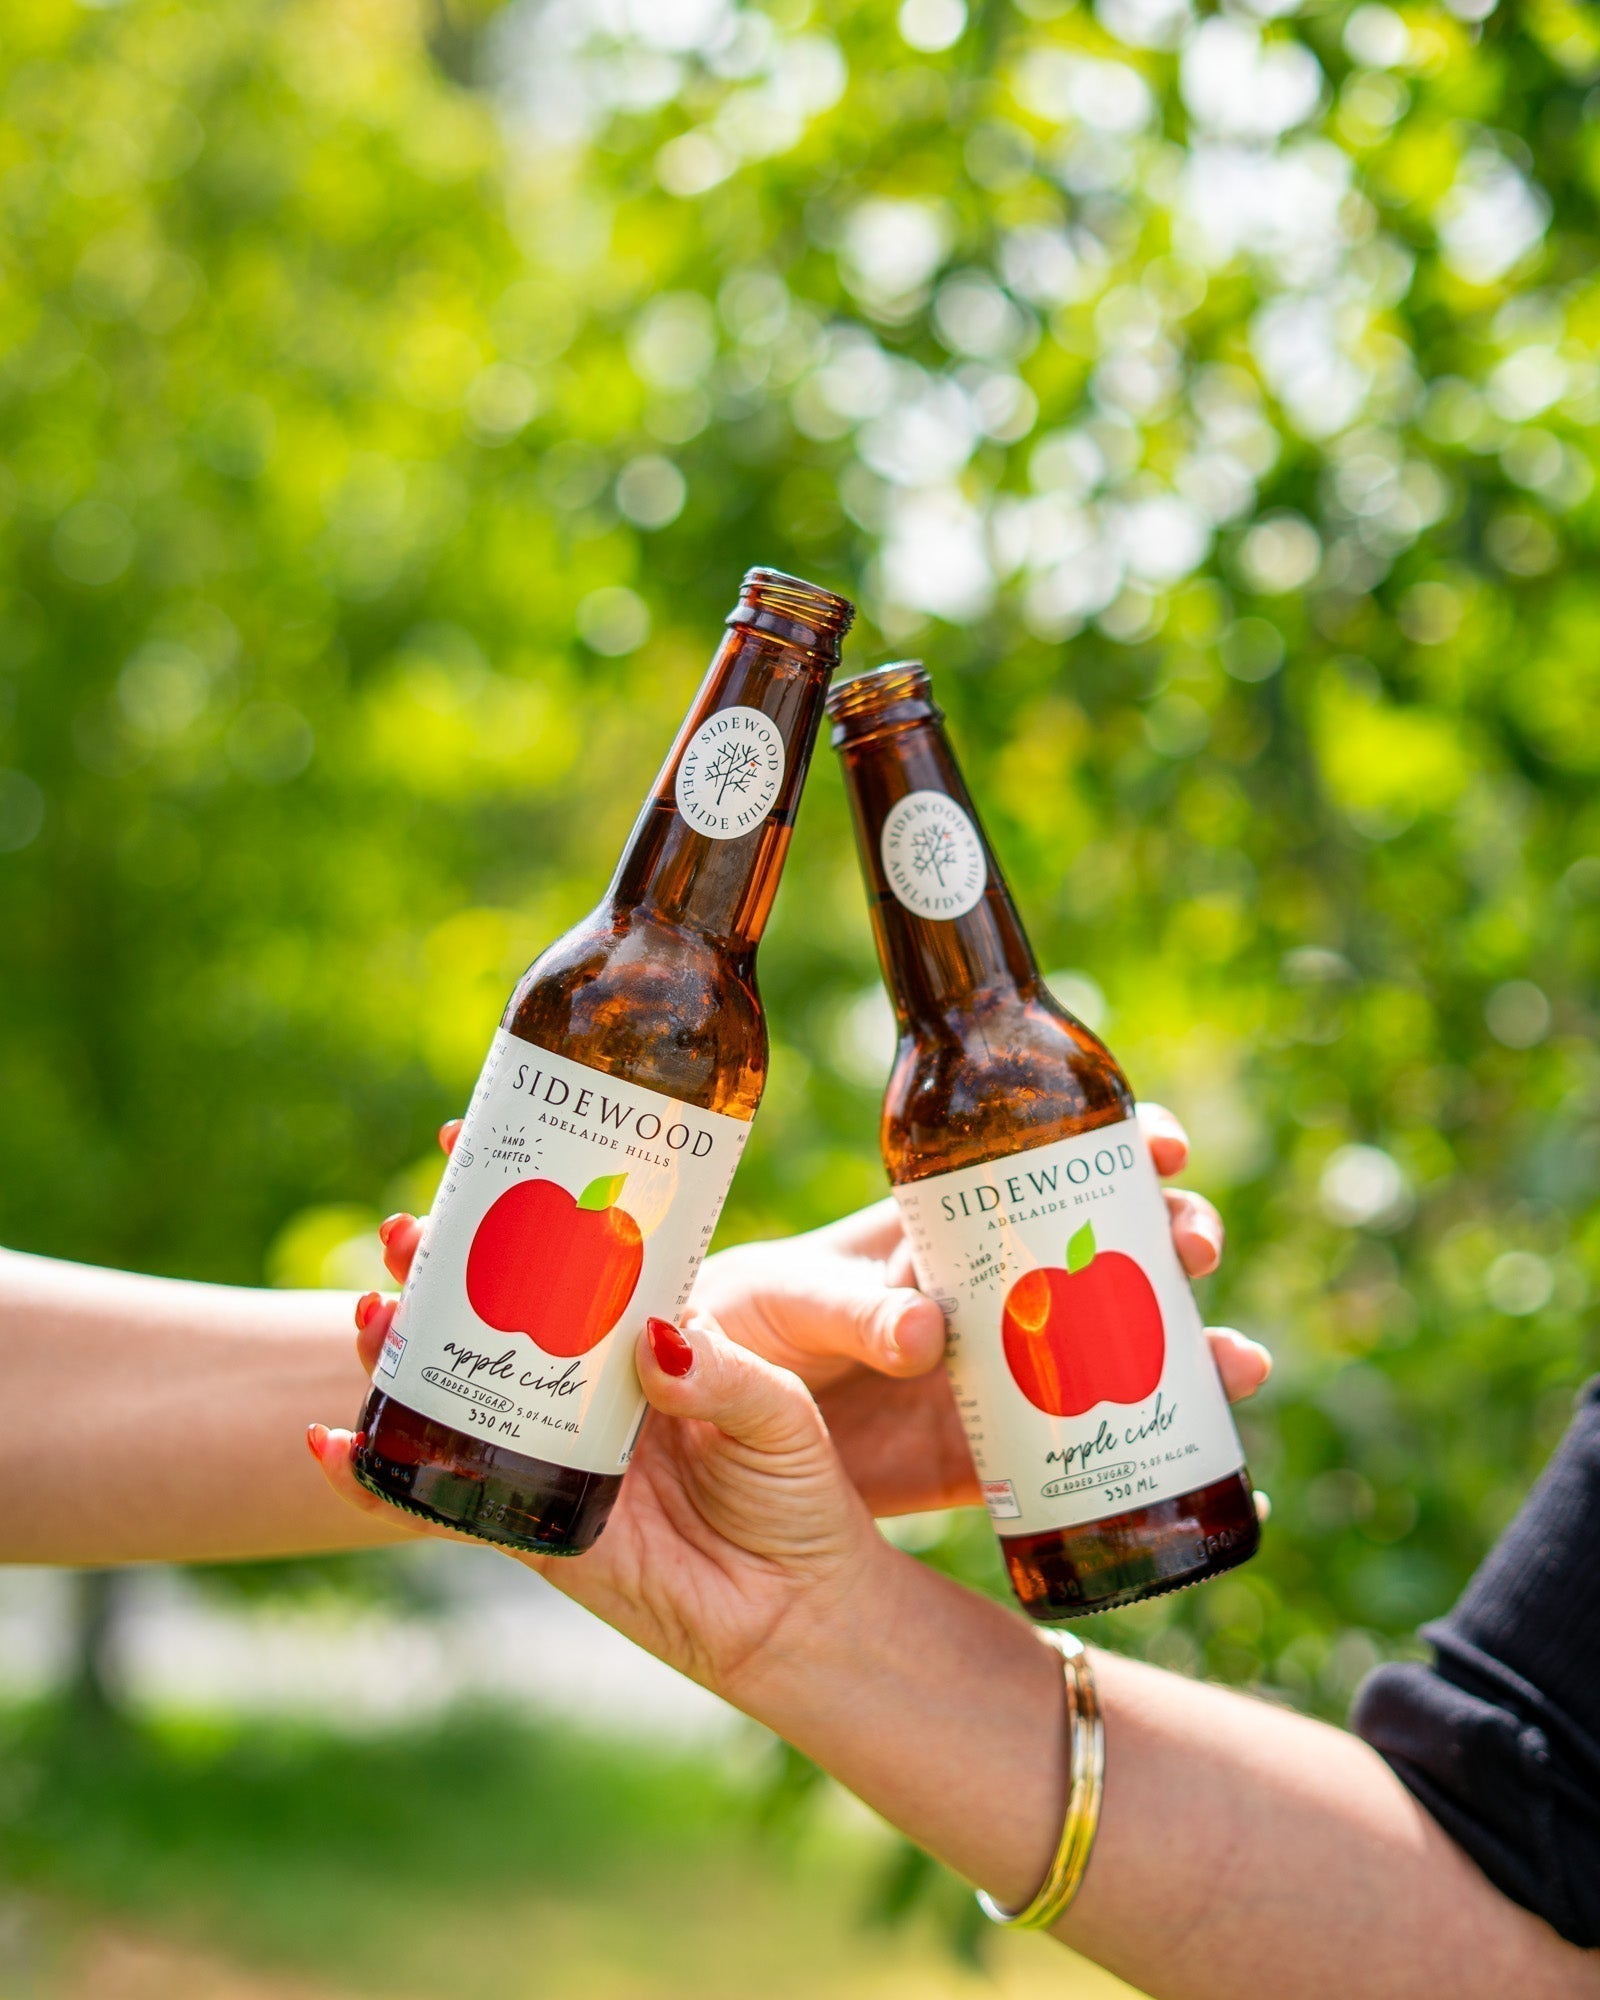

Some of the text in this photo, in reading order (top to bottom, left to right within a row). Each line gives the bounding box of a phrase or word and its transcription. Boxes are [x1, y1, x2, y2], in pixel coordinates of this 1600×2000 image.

[701, 717, 778, 771] SIDEWOOD
[682, 751, 776, 830] ADELAIDE HILLS
[889, 803, 966, 849] SIDEWOOD
[889, 840, 979, 910] ADELAIDE HILLS
[512, 1064, 714, 1157] SIDEWOOD
[492, 1149, 531, 1163] CRAFTED
[501, 1136, 526, 1147] HAND
[538, 1112, 671, 1168] ADELAIDE HILLS
[941, 1143, 1135, 1222] SIDEWOOD
[987, 1184, 1116, 1231] ADELAIDE HILLS
[969, 1253, 993, 1270] HAND
[969, 1262, 1006, 1287] CRAFTED
[425, 1369, 507, 1411] NO ADDED SUGAR
[443, 1342, 517, 1379] apple
[519, 1360, 588, 1398] cider
[468, 1408, 521, 1438] 330 ML
[1045, 1391, 1177, 1475] apple cider
[1046, 1464, 1132, 1495] NO ADDED SUGAR
[1104, 1475, 1158, 1502] 330 ML
